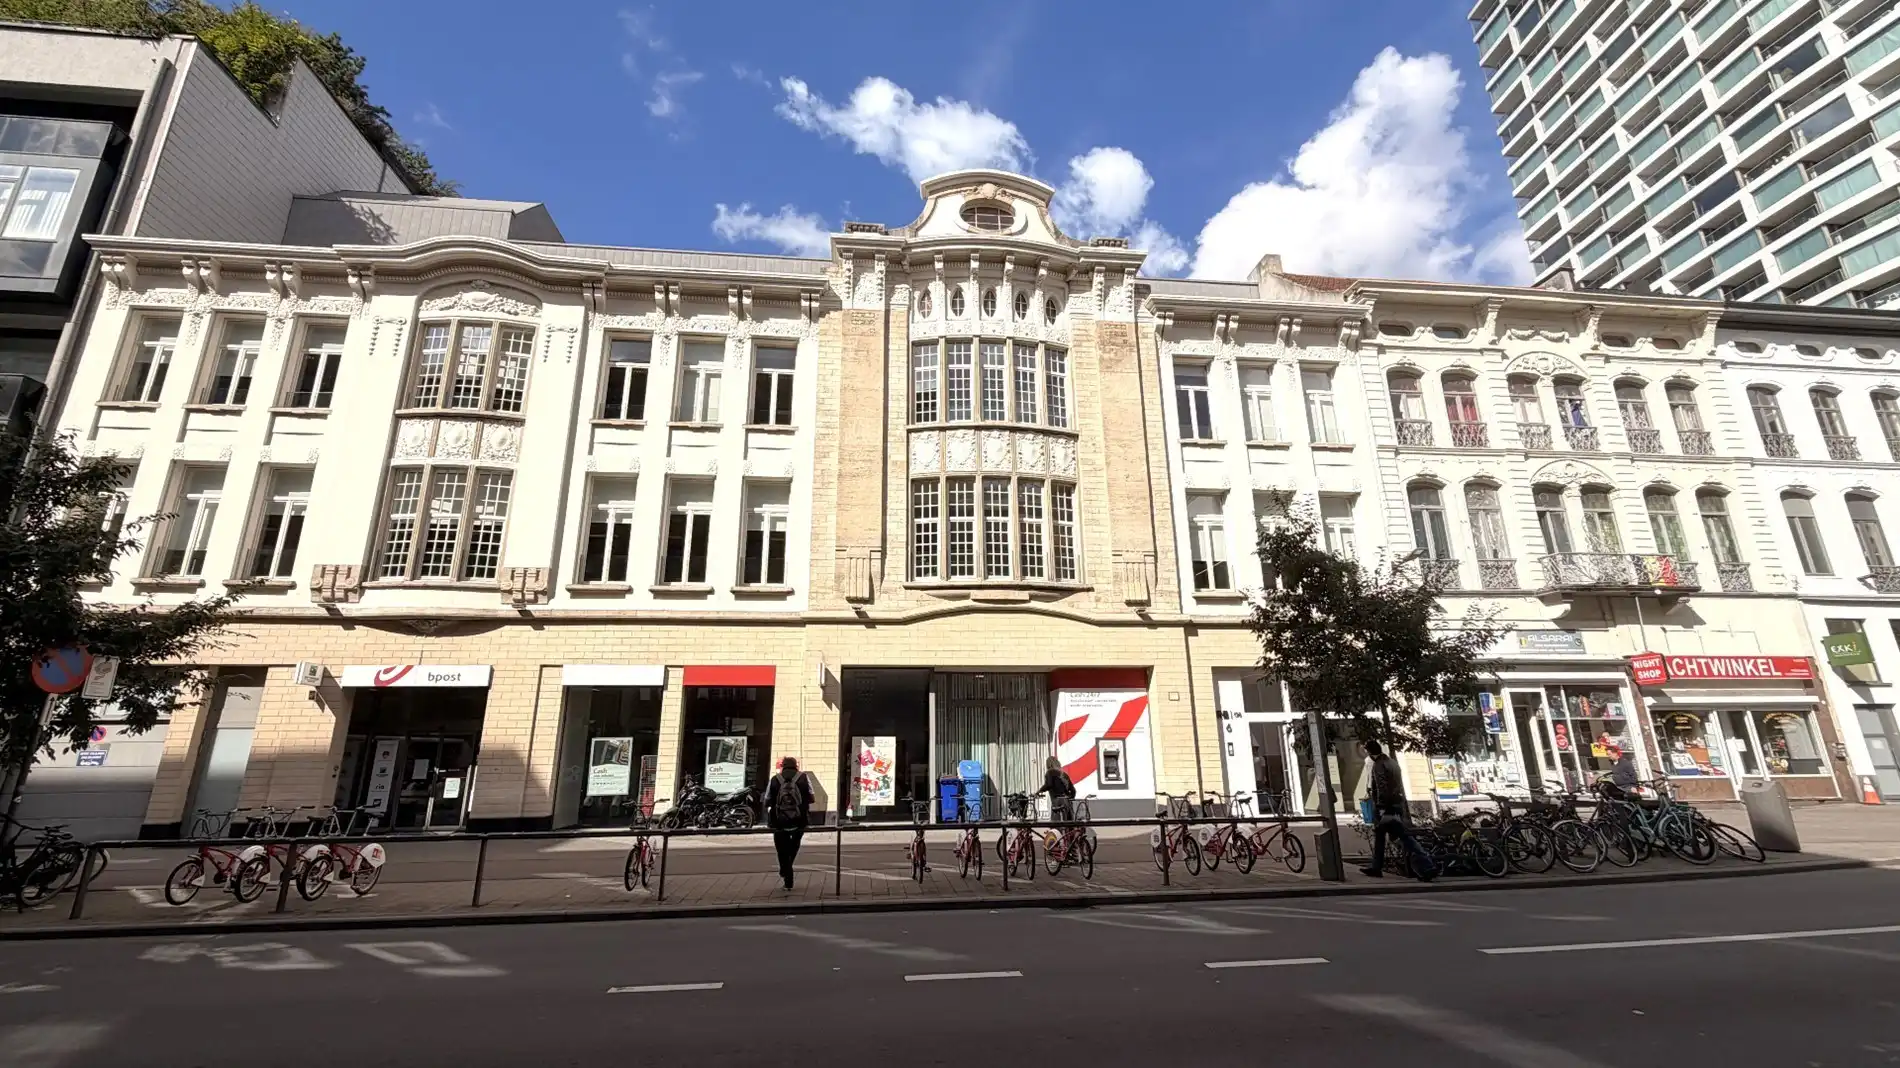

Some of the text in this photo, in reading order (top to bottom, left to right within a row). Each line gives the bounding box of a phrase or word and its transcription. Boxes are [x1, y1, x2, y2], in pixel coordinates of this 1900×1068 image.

[1633, 659, 1660, 668] NIGHT
[428, 672, 461, 683] bpost
[1638, 669, 1661, 679] SHOP
